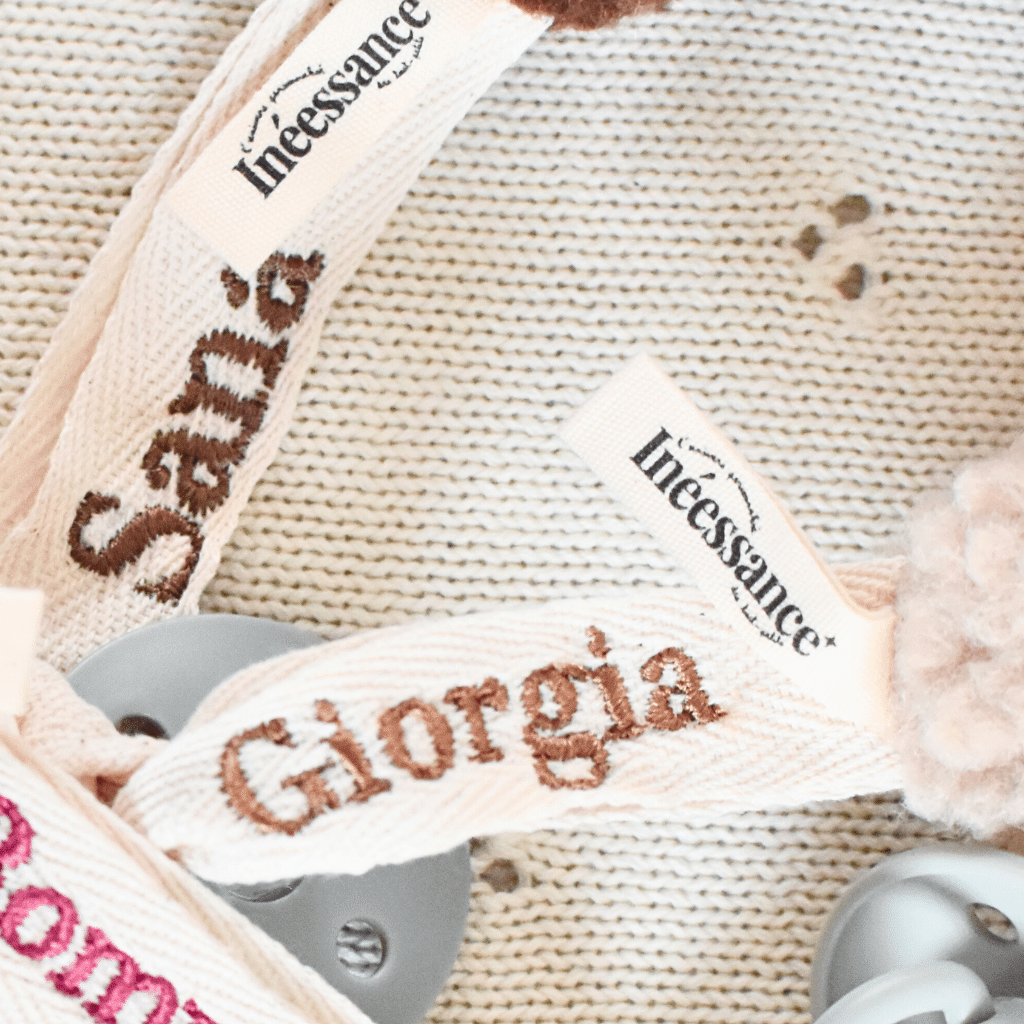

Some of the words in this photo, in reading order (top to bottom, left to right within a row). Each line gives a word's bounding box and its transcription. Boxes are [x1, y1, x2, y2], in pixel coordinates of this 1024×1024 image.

[232, 0, 430, 199] Inéessance
[629, 426, 820, 656] Inéessance
[216, 626, 729, 838] Giorgia
